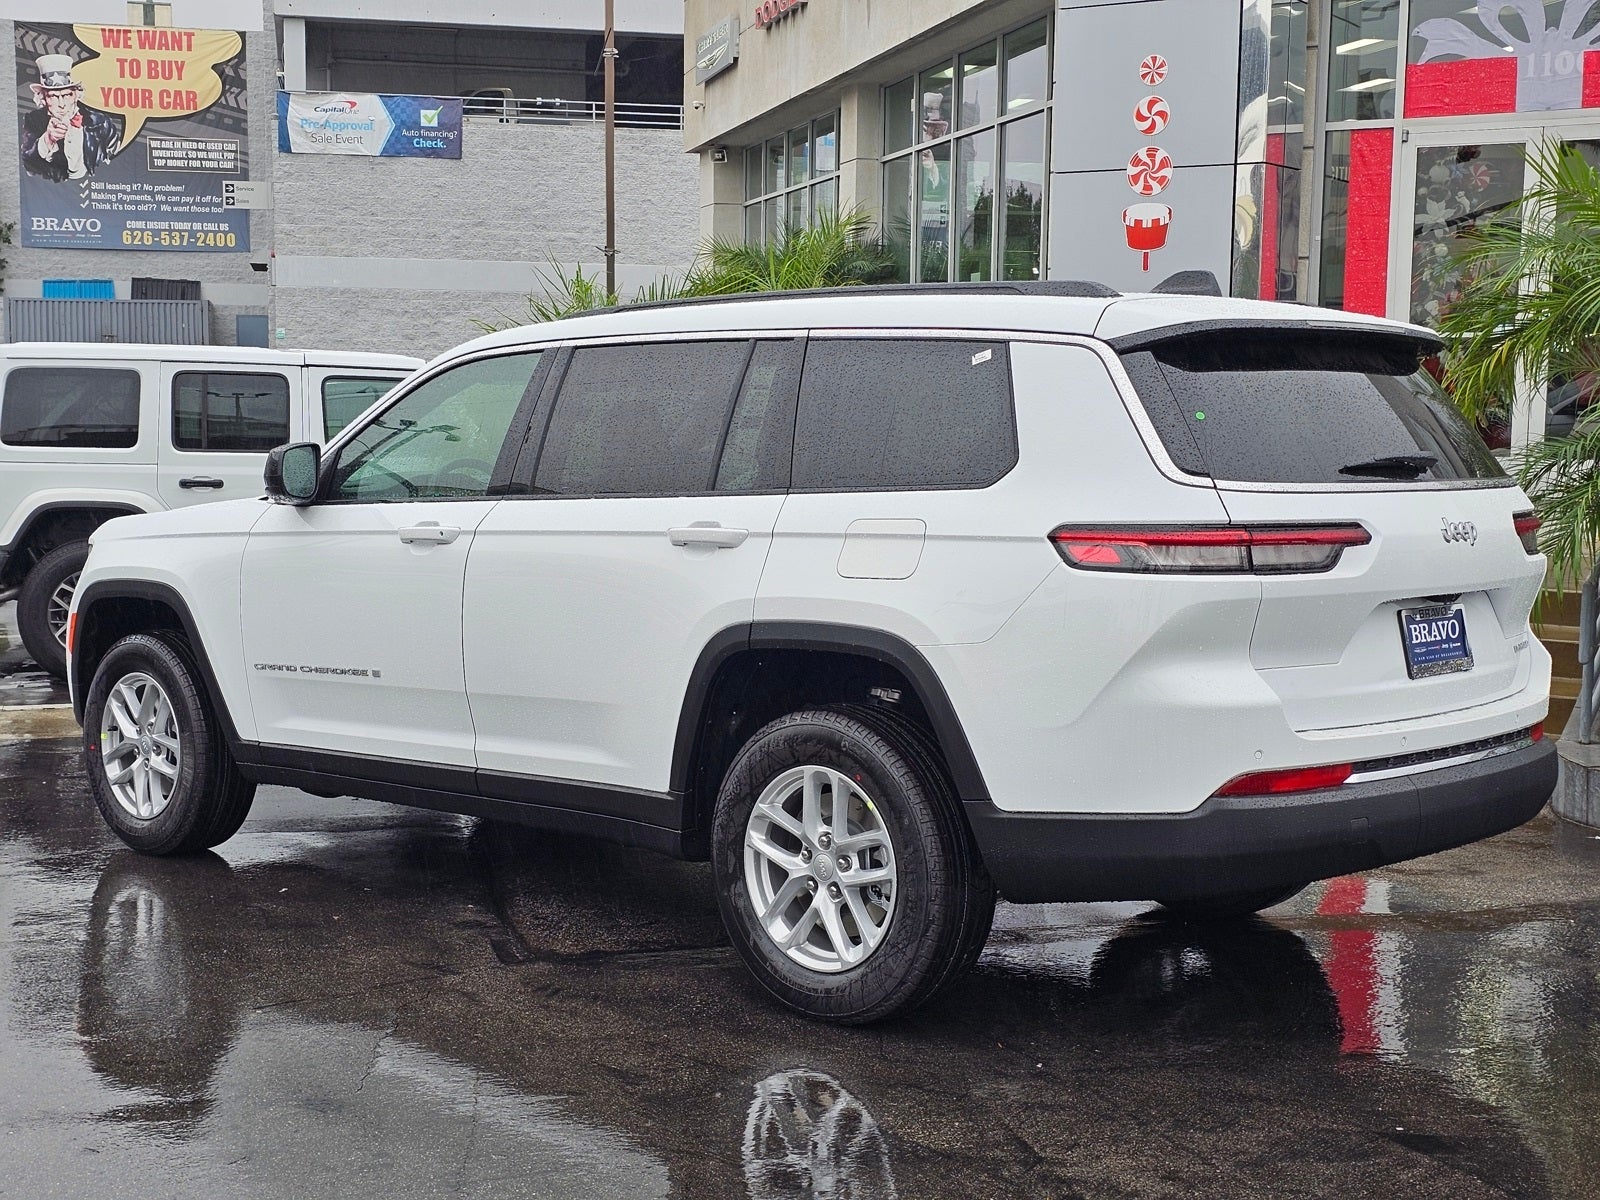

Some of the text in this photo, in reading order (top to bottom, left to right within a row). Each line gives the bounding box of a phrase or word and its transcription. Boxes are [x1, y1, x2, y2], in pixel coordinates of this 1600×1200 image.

[100, 28, 195, 52] WE WANT
[116, 58, 186, 80] TO BUY
[100, 86, 198, 110] YOUR CAR
[300, 118, 374, 132] Pre-Approval
[311, 133, 364, 144] Sale Event
[420, 129, 458, 140] financing?
[198, 142, 206, 150] OF
[223, 143, 236, 151] CAR
[413, 138, 447, 148] Check.
[152, 150, 187, 158] INVENTORY,
[197, 151, 208, 159] WE
[167, 159, 188, 167] MONEY
[202, 160, 219, 168] YOUR
[90, 182, 104, 190] Still
[106, 182, 131, 192] leasing
[132, 183, 142, 191] it?
[154, 184, 185, 193] problem!
[91, 192, 116, 201] Making
[118, 193, 154, 202] Payments,
[155, 194, 166, 202] We
[181, 196, 194, 204] pay
[201, 195, 212, 203] off
[91, 202, 111, 210] Think
[160, 204, 171, 212] We
[190, 205, 210, 213] those
[31, 217, 102, 232] BRAVO
[147, 221, 169, 229] INSIDE
[170, 222, 192, 230] TODAY
[192, 222, 202, 230] OR
[203, 223, 219, 231] CALL
[220, 223, 229, 231] US
[122, 230, 236, 247] 626-537-2400
[1440, 516, 1478, 546] Jeep
[1418, 606, 1446, 618] BRAVO
[1409, 620, 1460, 644] BRAVO
[254, 663, 297, 672] GRAND
[300, 666, 369, 676] CHEROKEE
